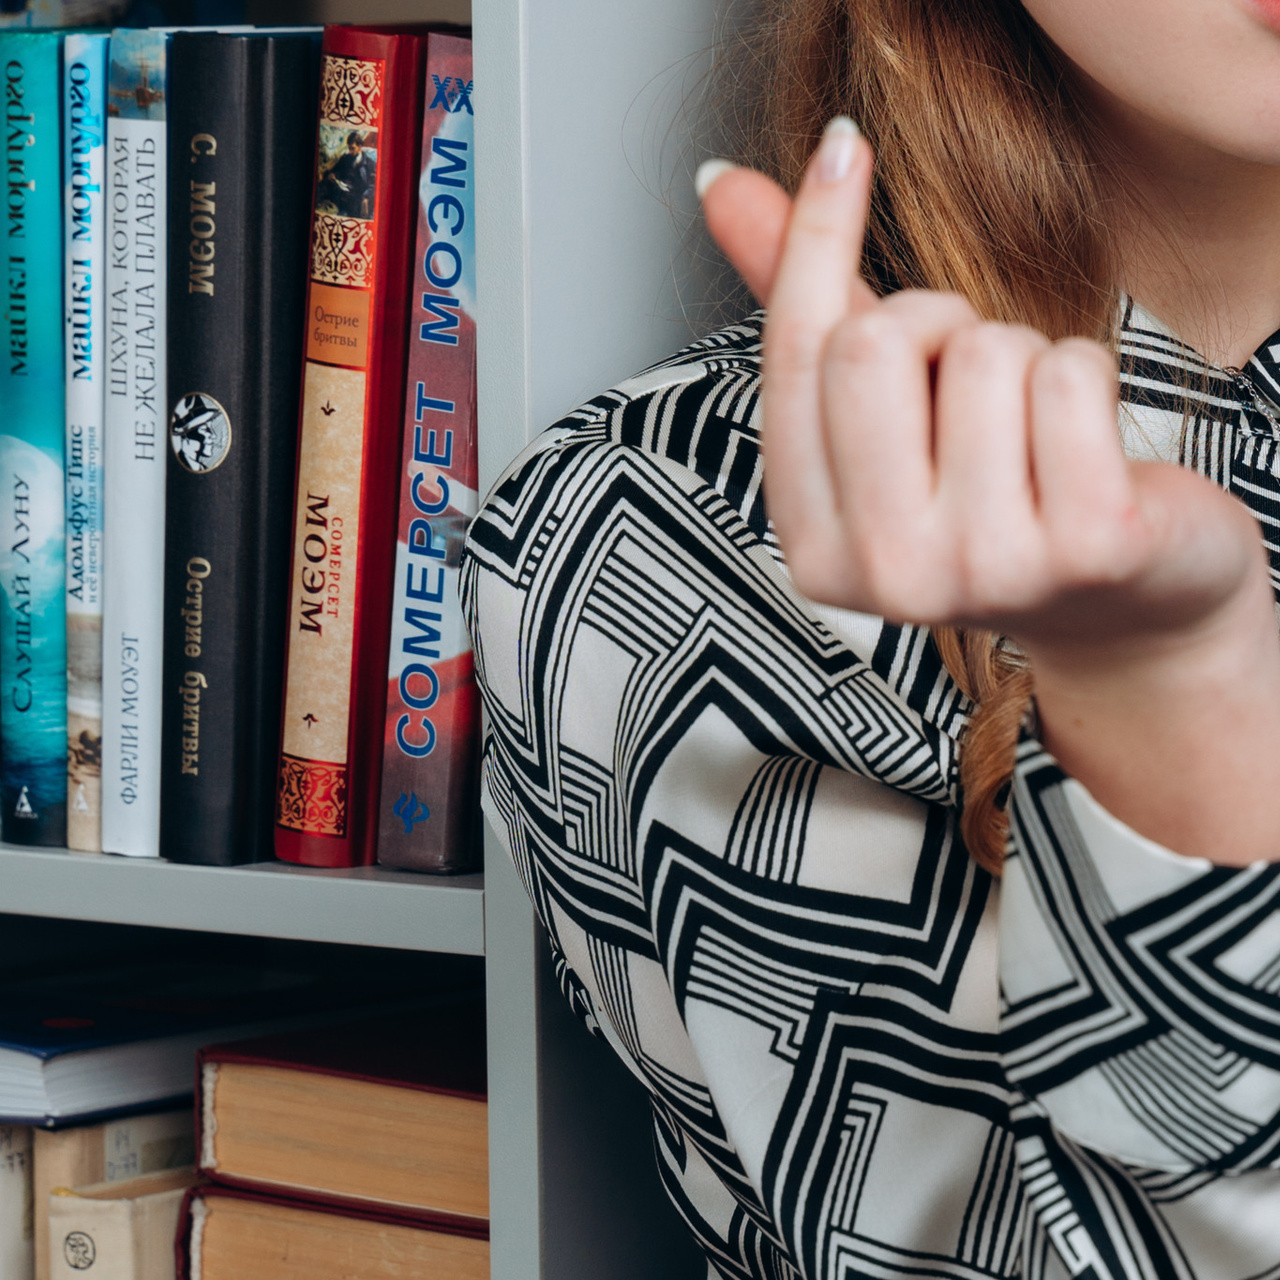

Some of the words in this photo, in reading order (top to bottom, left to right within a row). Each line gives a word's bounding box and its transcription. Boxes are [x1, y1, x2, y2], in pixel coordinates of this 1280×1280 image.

[6, 60, 35, 238] морпурго
[70, 62, 101, 243] морпурго
[112, 137, 130, 270] КОТОРАЯ
[136, 138, 155, 273] ПЛАВАТЬ
[190, 132, 217, 164] С.
[189, 180, 217, 297] МОЭМ
[420, 137, 468, 347] МОЭМ
[5, 256, 28, 377] майкл
[68, 259, 92, 382] майкл
[111, 281, 130, 396] ШХУНА,
[135, 283, 157, 415] ЖЕЛАЛА
[313, 326, 358, 348] бритвы
[314, 305, 359, 328] Острие
[135, 421, 155, 461] НЕ
[183, 556, 211, 658] Острие
[299, 490, 330, 637] МОЭМ
[327, 517, 344, 619] СОМЕРСЕТ
[395, 381, 456, 758] СОМЕРСЕТ
[121, 632, 139, 717] МОУЭТ
[180, 670, 208, 776] бритвы
[120, 723, 139, 805] ФАРЛИ
